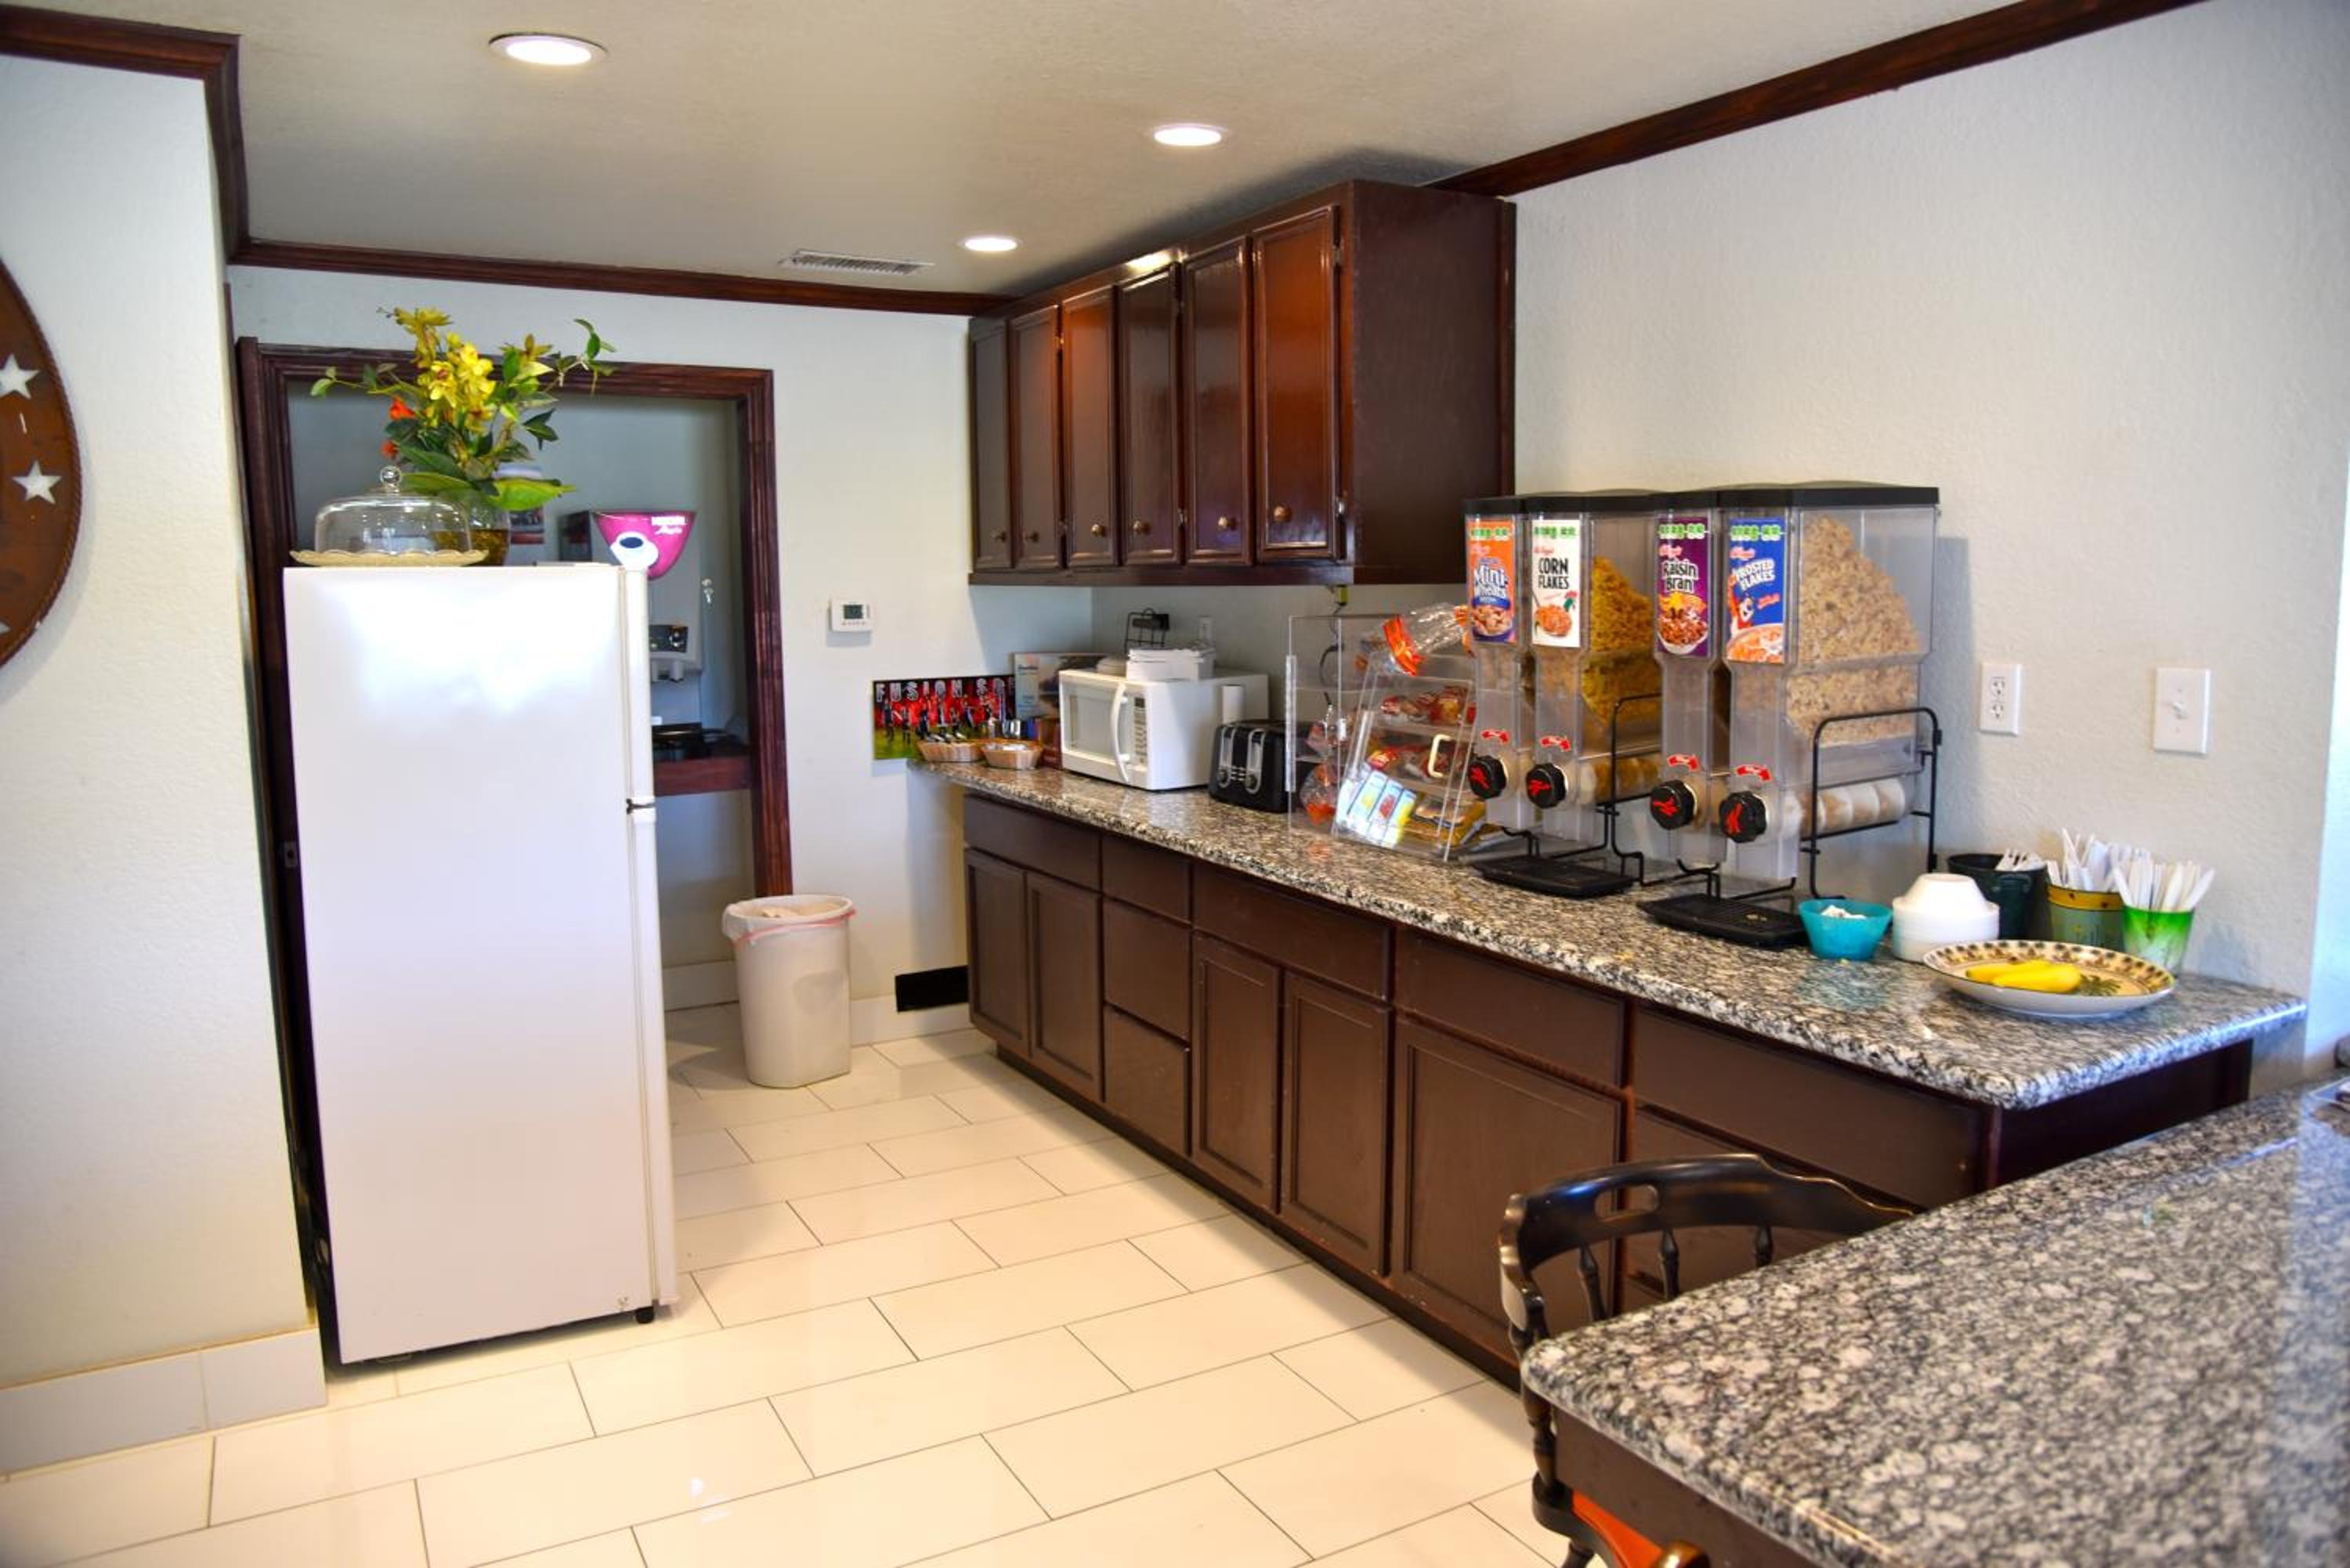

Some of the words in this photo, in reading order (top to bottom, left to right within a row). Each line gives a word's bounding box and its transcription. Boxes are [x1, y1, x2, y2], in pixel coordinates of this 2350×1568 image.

[1538, 558, 1569, 574] CORN
[1662, 558, 1699, 580] Raisin
[1538, 576, 1570, 589] FLAKES
[1665, 576, 1694, 592] Bran
[1739, 570, 1776, 591] FLAKES
[875, 678, 963, 703] FUSION
